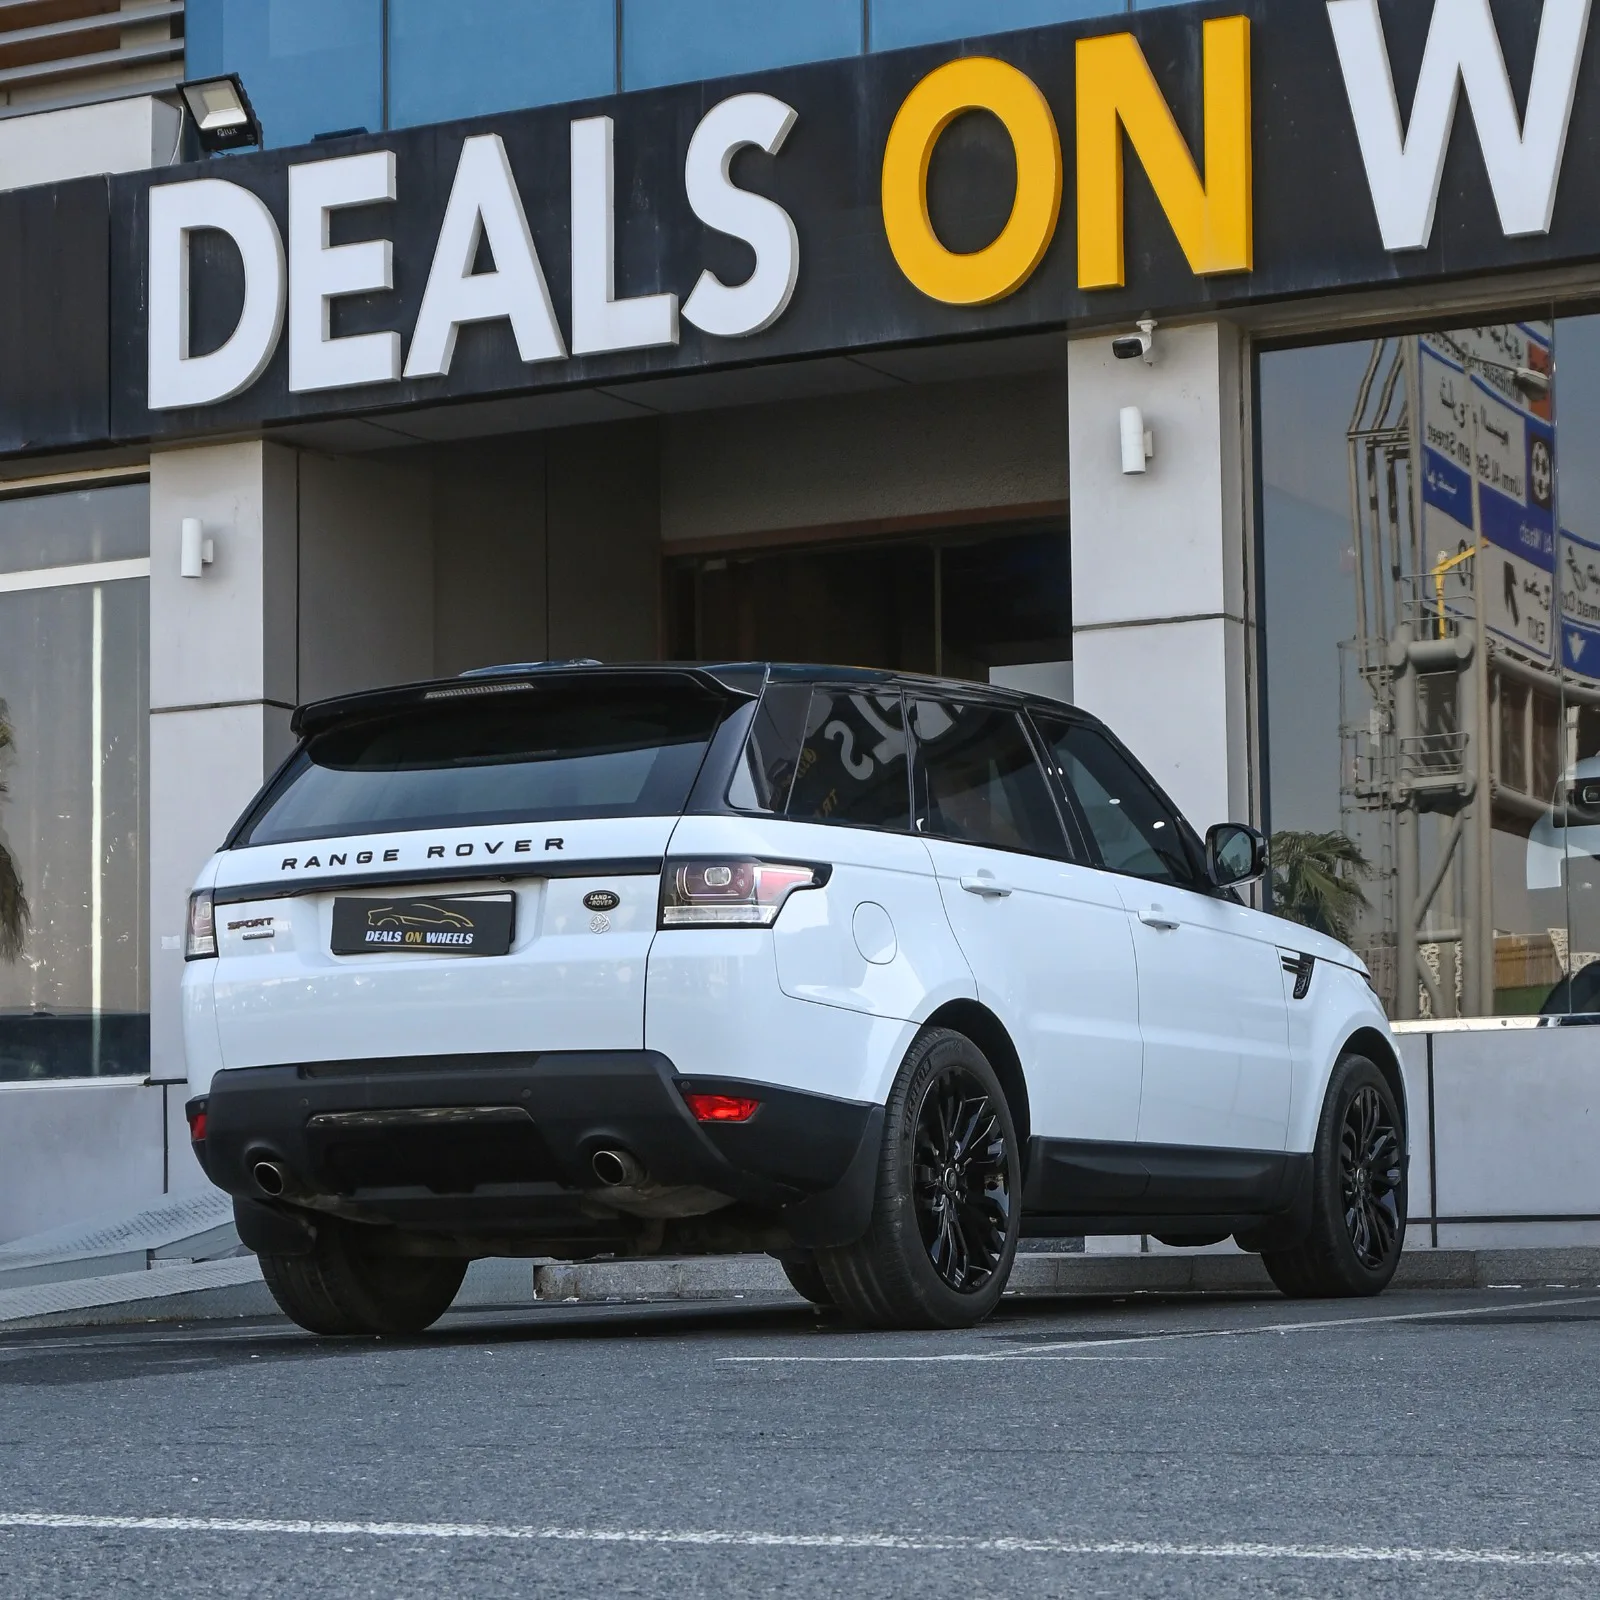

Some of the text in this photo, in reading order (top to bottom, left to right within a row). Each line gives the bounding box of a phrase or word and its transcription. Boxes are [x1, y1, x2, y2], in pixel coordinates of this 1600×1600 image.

[148, 93, 799, 410] DEALS
[882, 15, 1253, 306] ON
[281, 837, 565, 871] RANGE ROVER
[227, 917, 274, 930] SPORT
[365, 930, 473, 945] DEALS ON WHEELS
